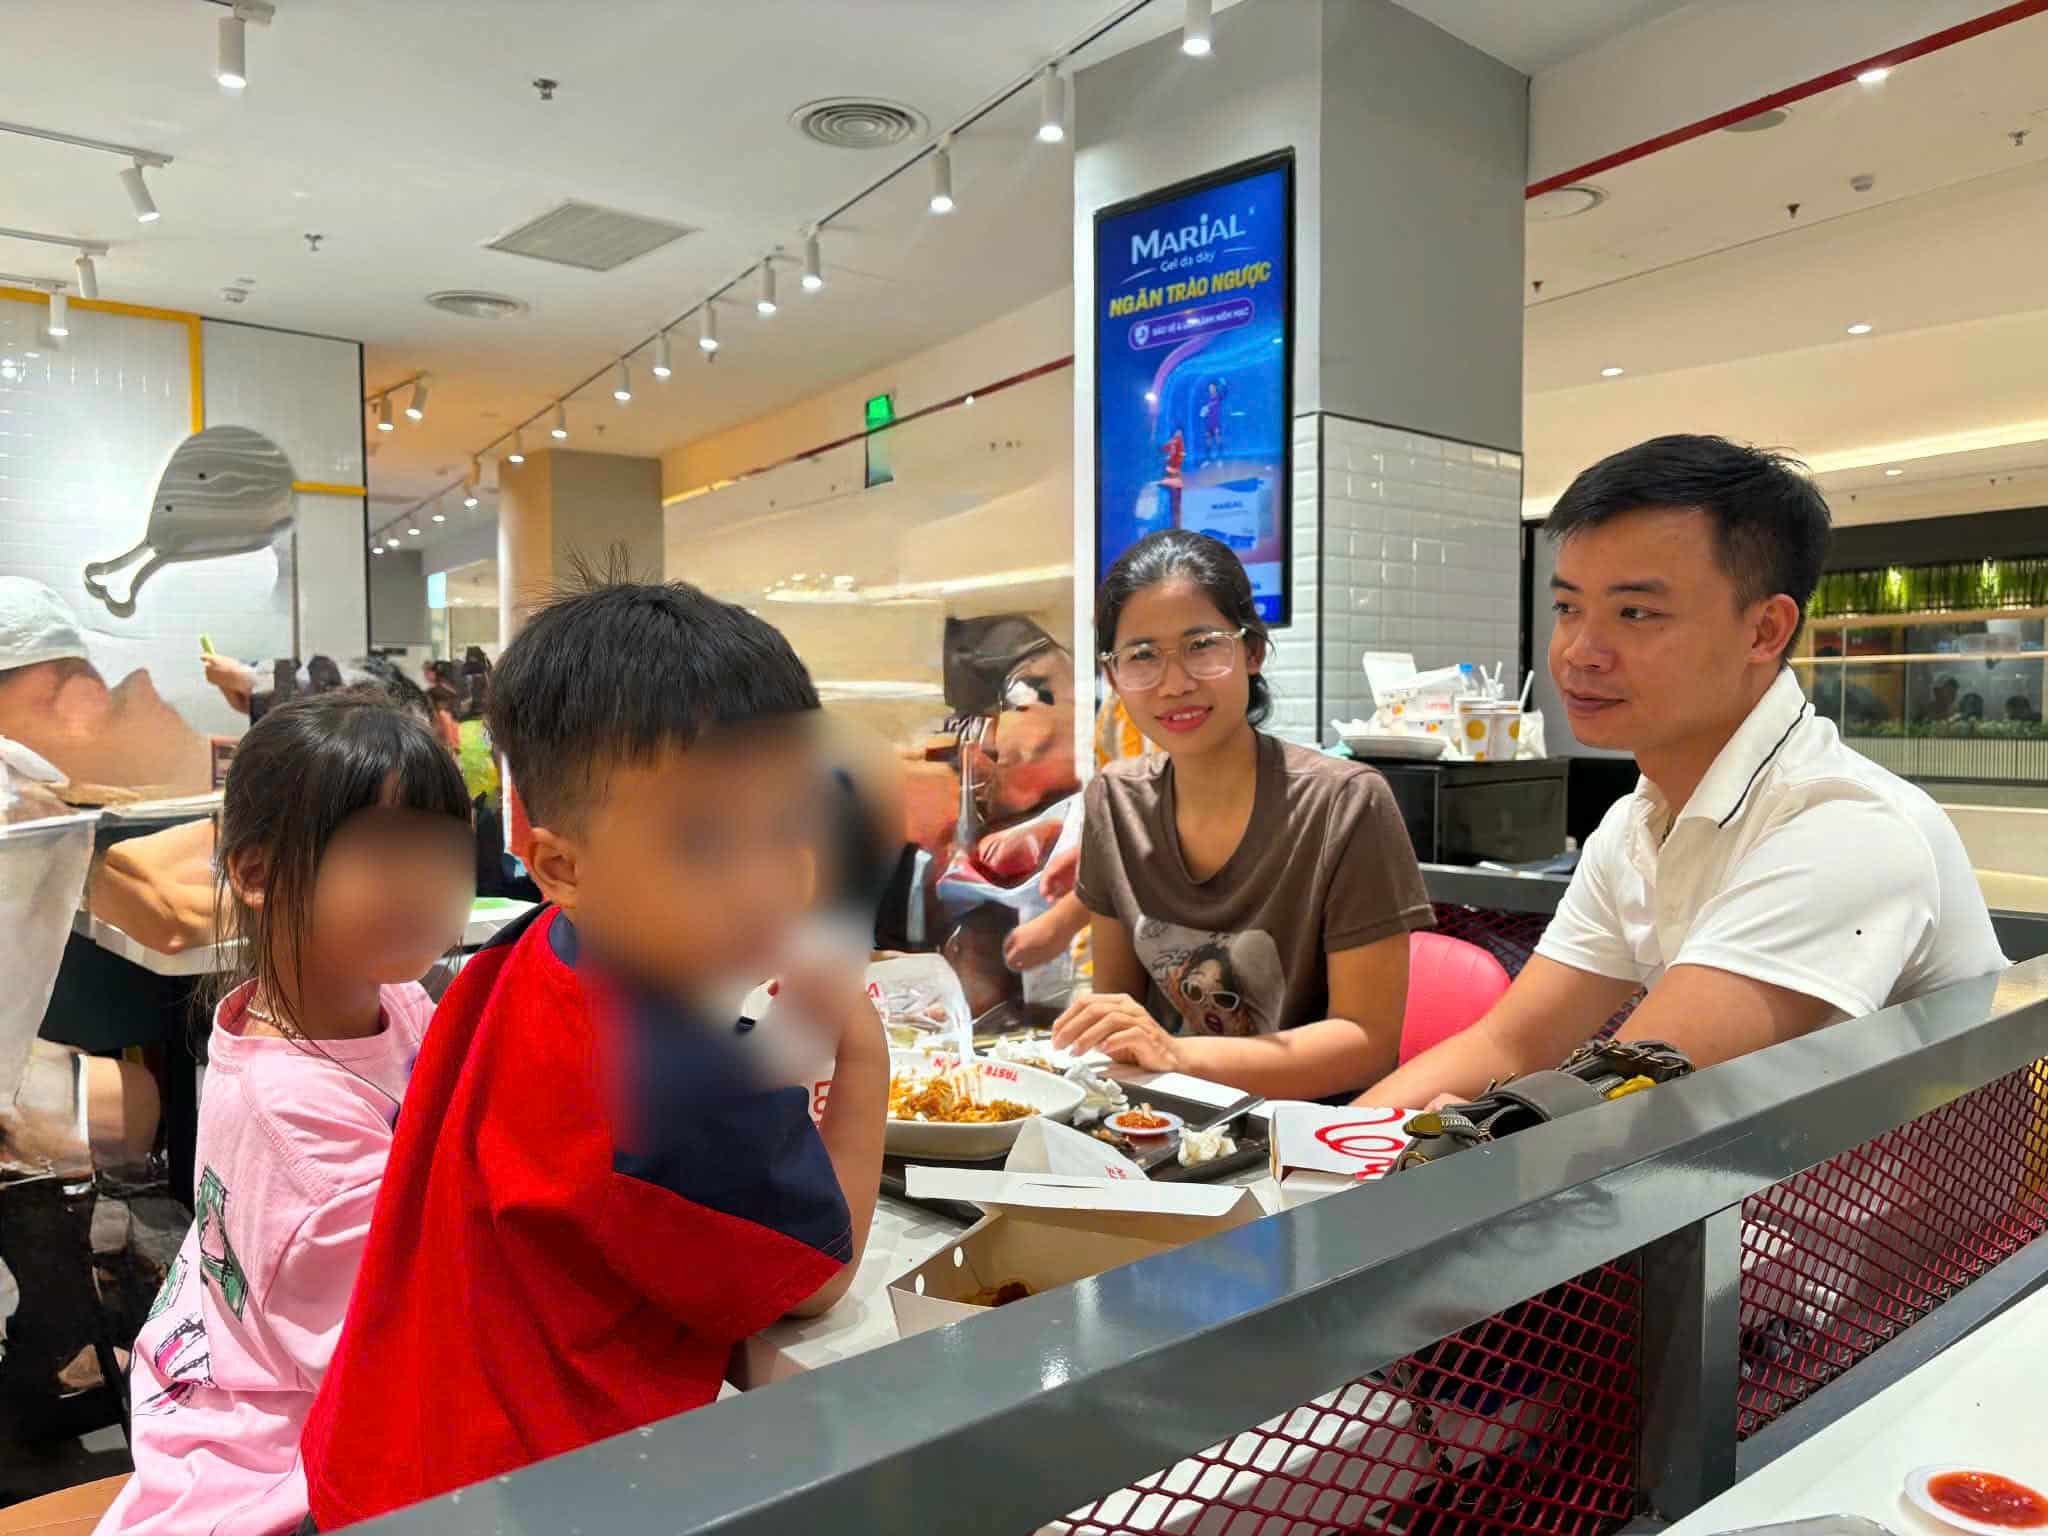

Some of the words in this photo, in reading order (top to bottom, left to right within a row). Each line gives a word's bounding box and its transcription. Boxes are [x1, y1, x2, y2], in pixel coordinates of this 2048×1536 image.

[1108, 287, 1163, 318] NGĂN
[1166, 276, 1208, 304] TRÀO
[1211, 261, 1272, 293] NGƯỢC
